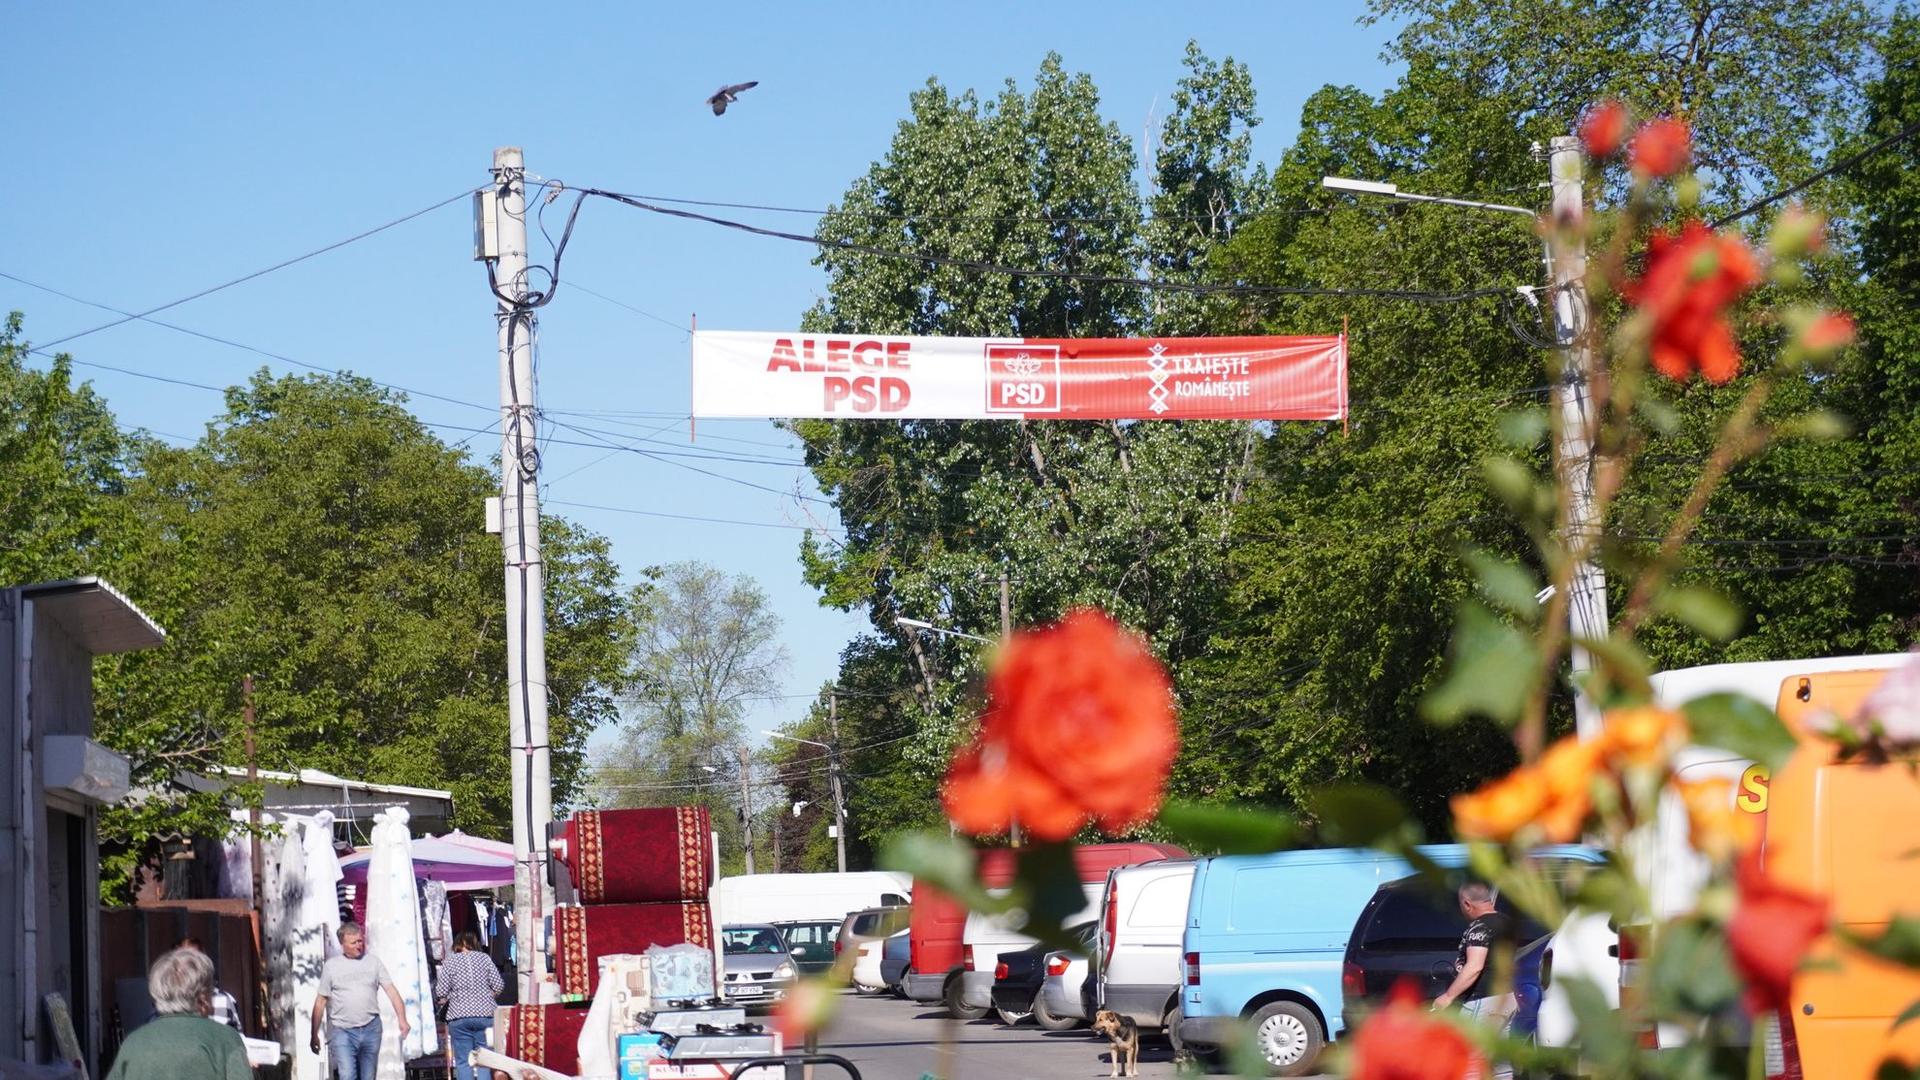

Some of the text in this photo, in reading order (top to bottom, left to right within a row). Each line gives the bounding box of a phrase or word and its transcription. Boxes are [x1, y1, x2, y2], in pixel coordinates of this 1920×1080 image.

[767, 338, 911, 373] ALEGE
[1172, 353, 1249, 380] TRĂIEȘTE
[824, 376, 911, 413] PSD
[1002, 382, 1045, 405] PSD
[1175, 376, 1250, 401] ROMÂNEȘTE
